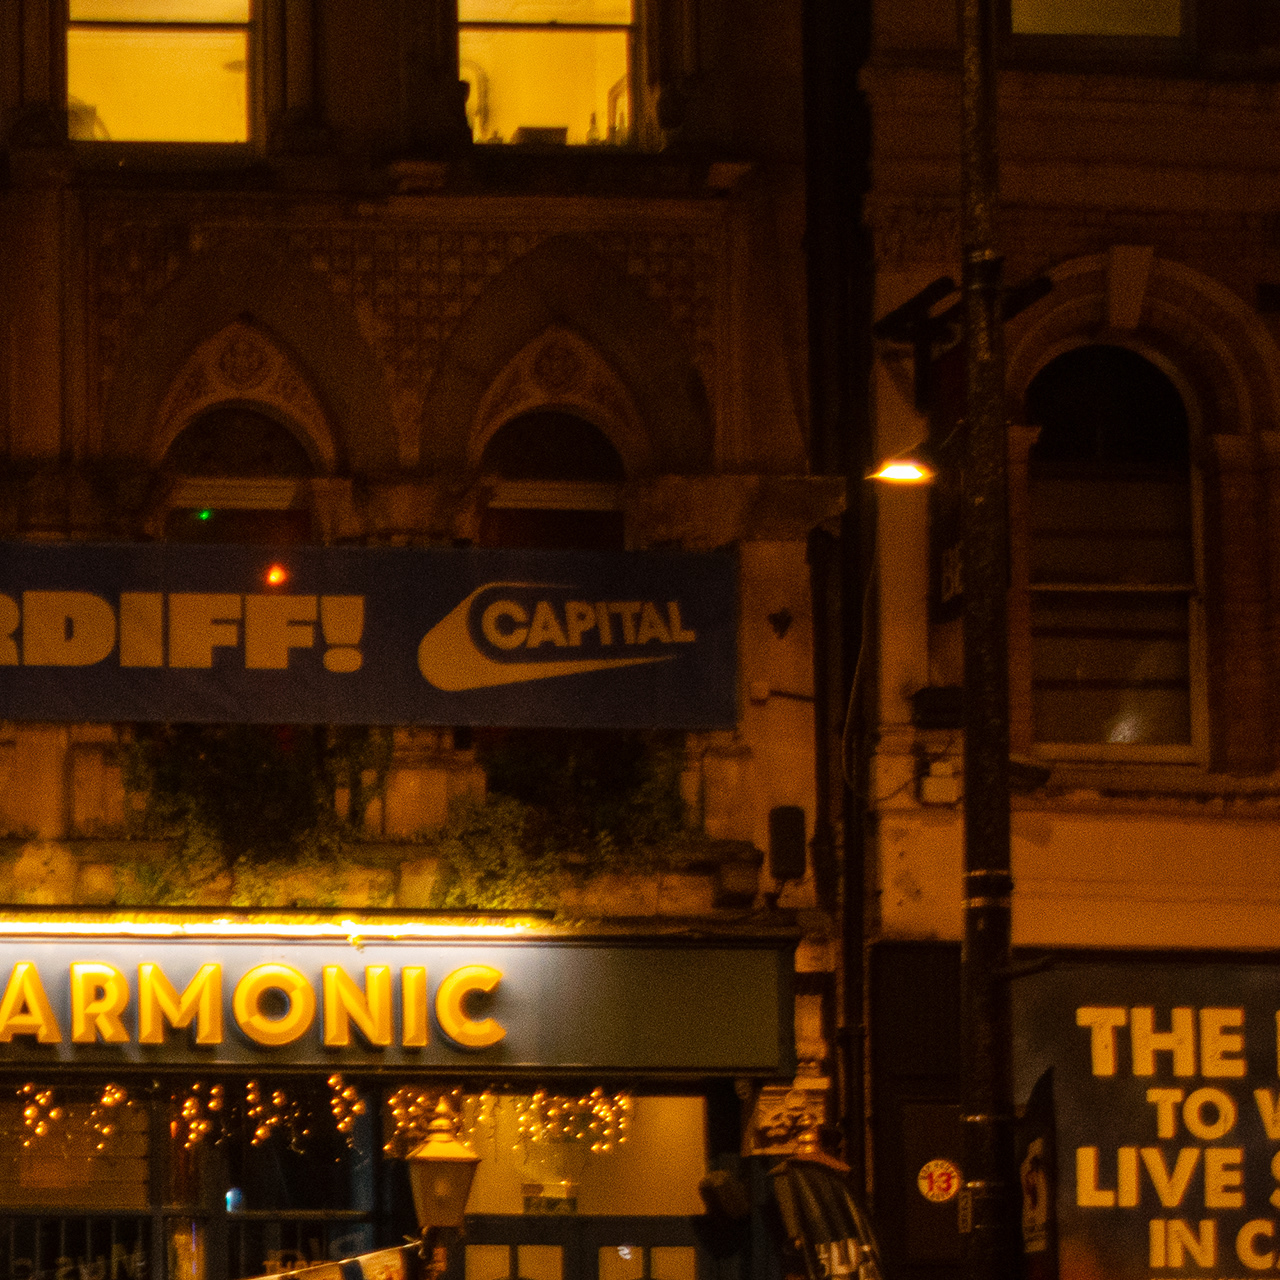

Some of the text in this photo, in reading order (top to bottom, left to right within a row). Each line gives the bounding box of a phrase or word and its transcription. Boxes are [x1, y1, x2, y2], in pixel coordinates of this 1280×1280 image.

[480, 599, 696, 652] CAPITAL
[1075, 1004, 1247, 1078] THE
[1145, 1087, 1237, 1140] TO
[927, 1171, 953, 1193] 13
[1075, 1146, 1245, 1209] LIVE
[1148, 1219, 1217, 1269] IN
